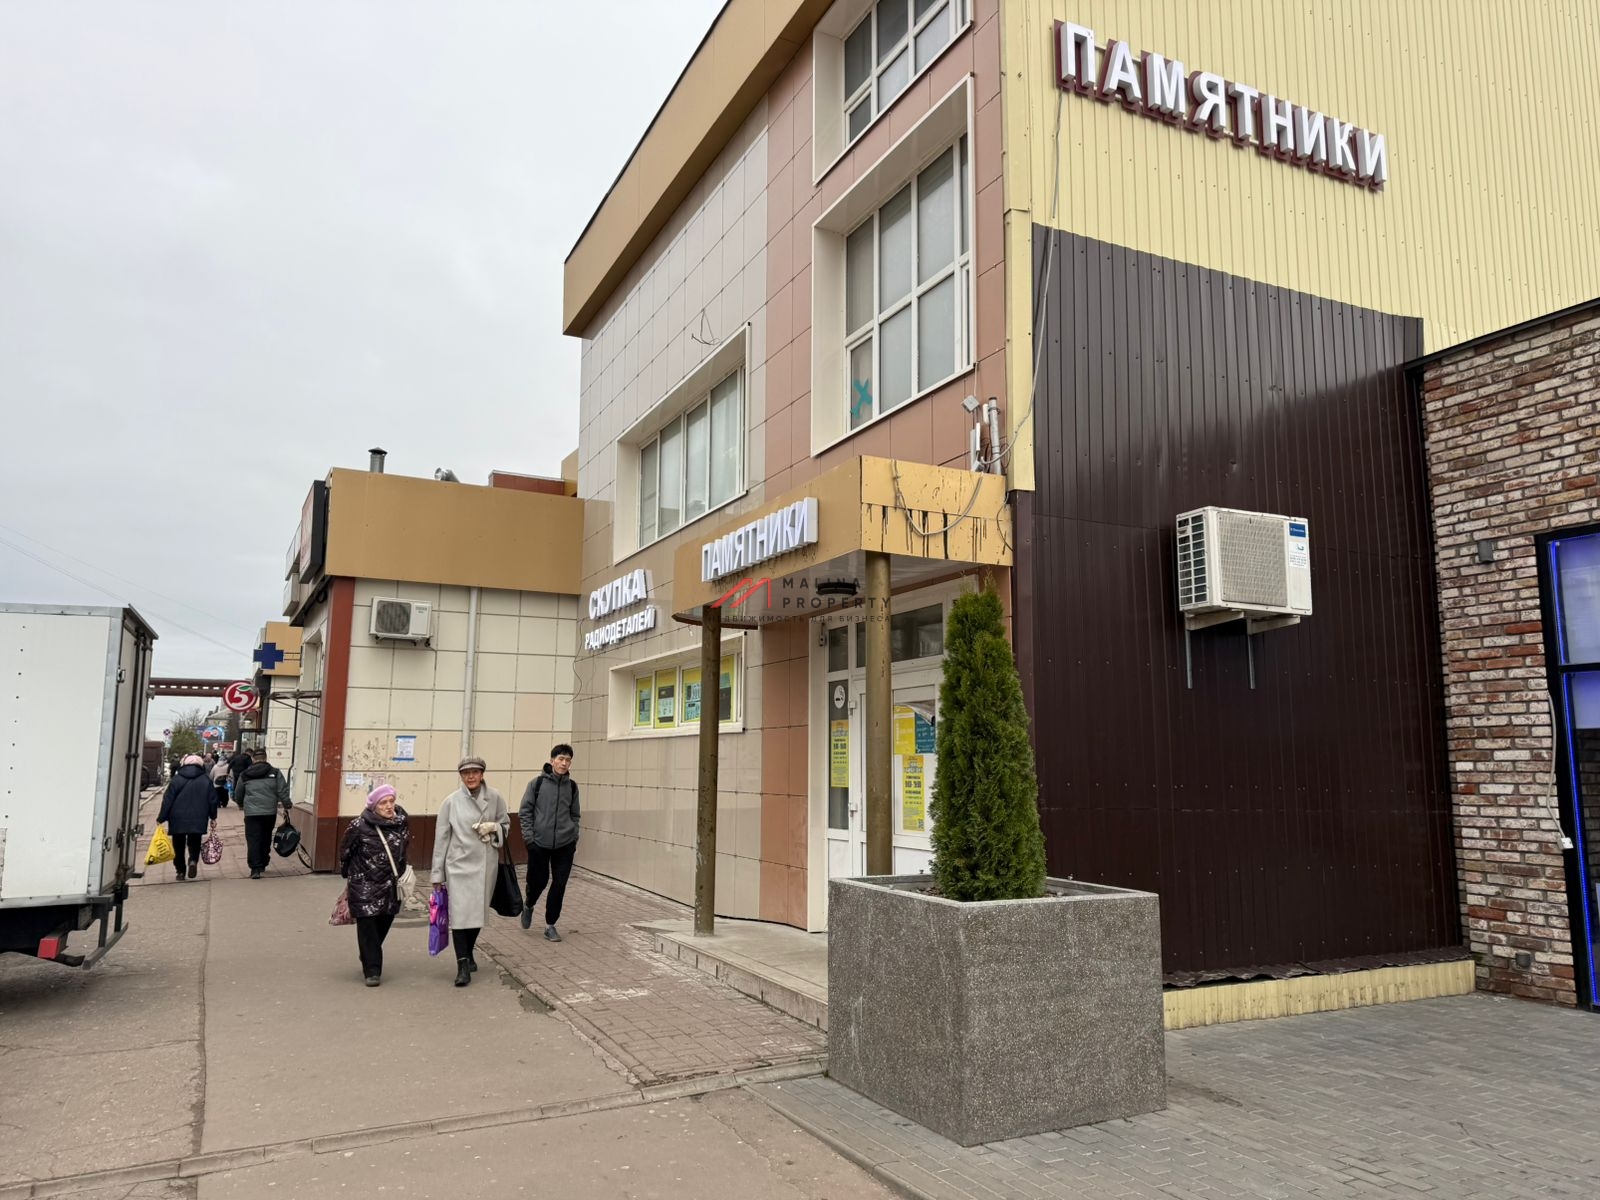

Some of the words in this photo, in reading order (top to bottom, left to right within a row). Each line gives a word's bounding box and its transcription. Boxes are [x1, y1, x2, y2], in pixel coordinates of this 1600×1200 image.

[1054, 19, 1386, 191] ПАМЯТНИКИ
[701, 496, 819, 582] ПАМЯТНИКИ
[584, 604, 657, 651] РАДИОДЕТАЛЕЙ
[588, 568, 648, 620] СКУПКА
